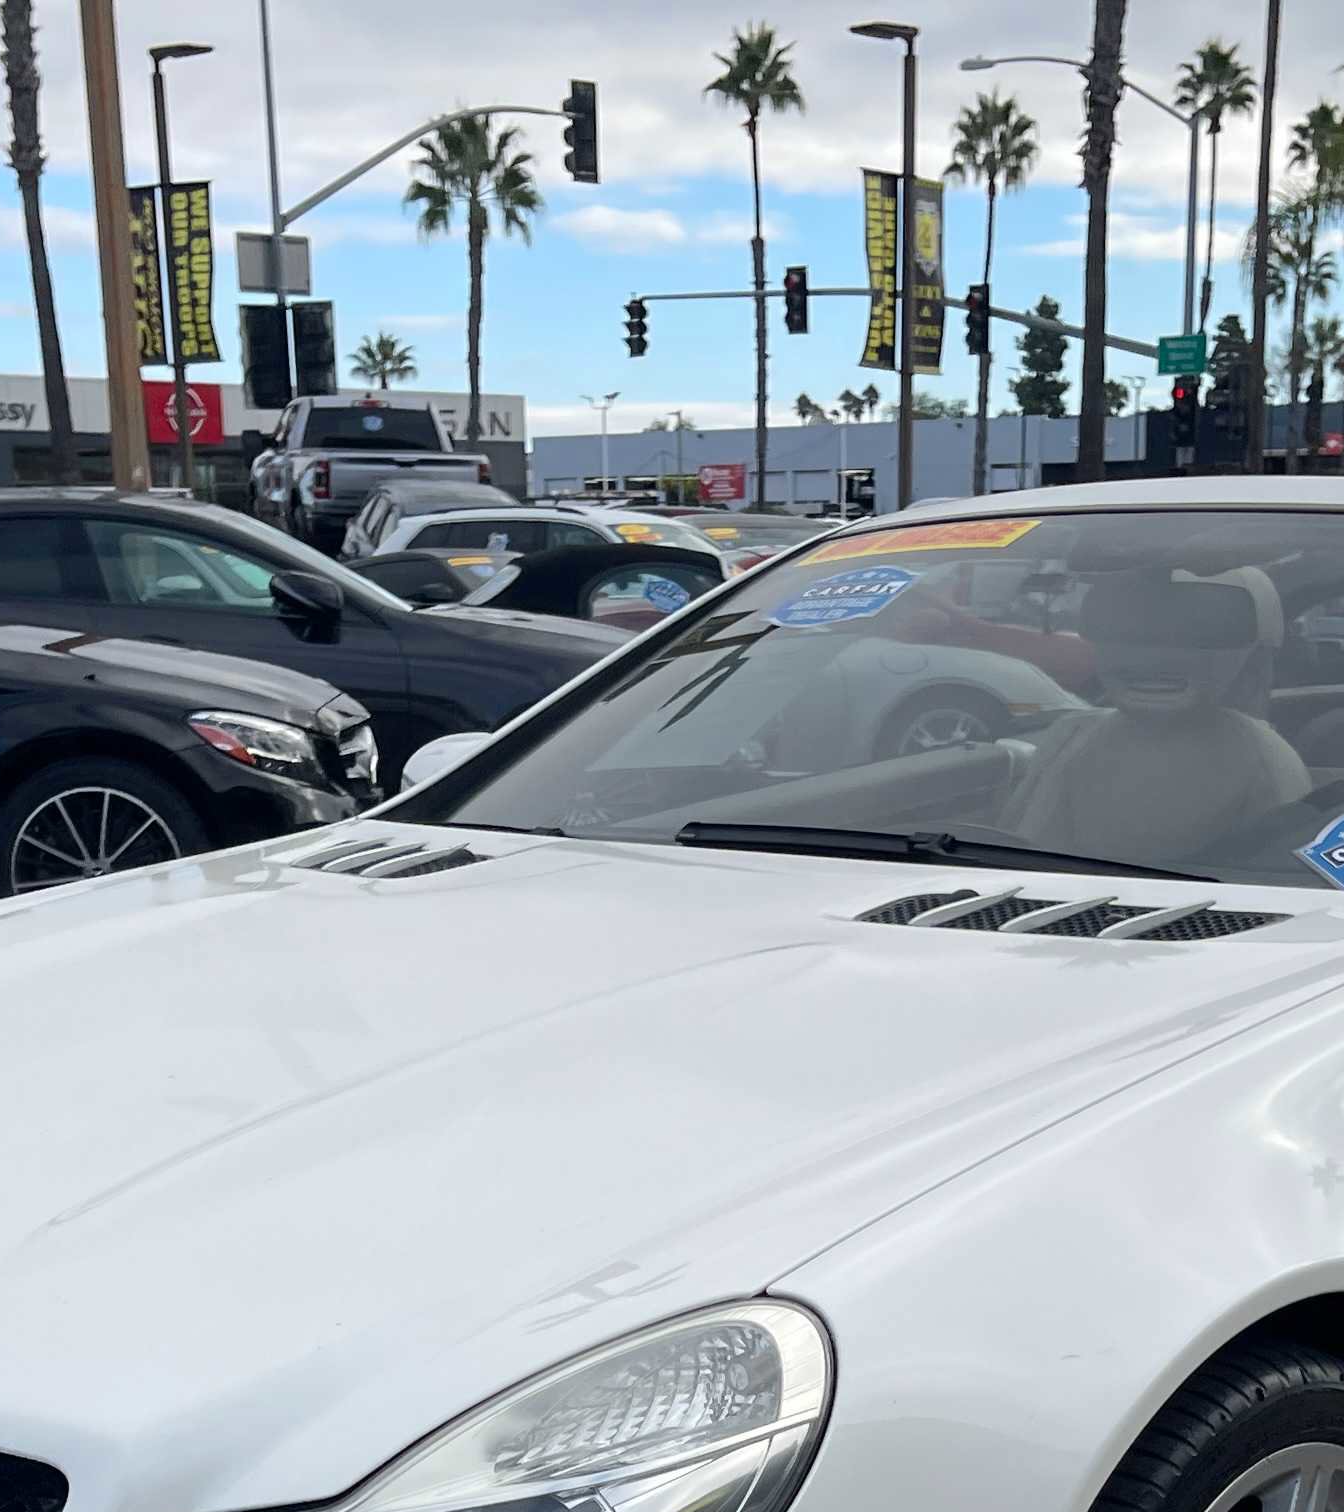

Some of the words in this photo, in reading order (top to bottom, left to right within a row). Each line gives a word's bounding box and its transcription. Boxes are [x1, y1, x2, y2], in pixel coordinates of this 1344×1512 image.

[170, 191, 189, 247] OUR
[191, 187, 208, 231] WE
[865, 175, 883, 290] SERVICE
[174, 252, 199, 357] TROOPS
[190, 237, 214, 354] SUPPORT
[802, 581, 906, 598] CARFAX
